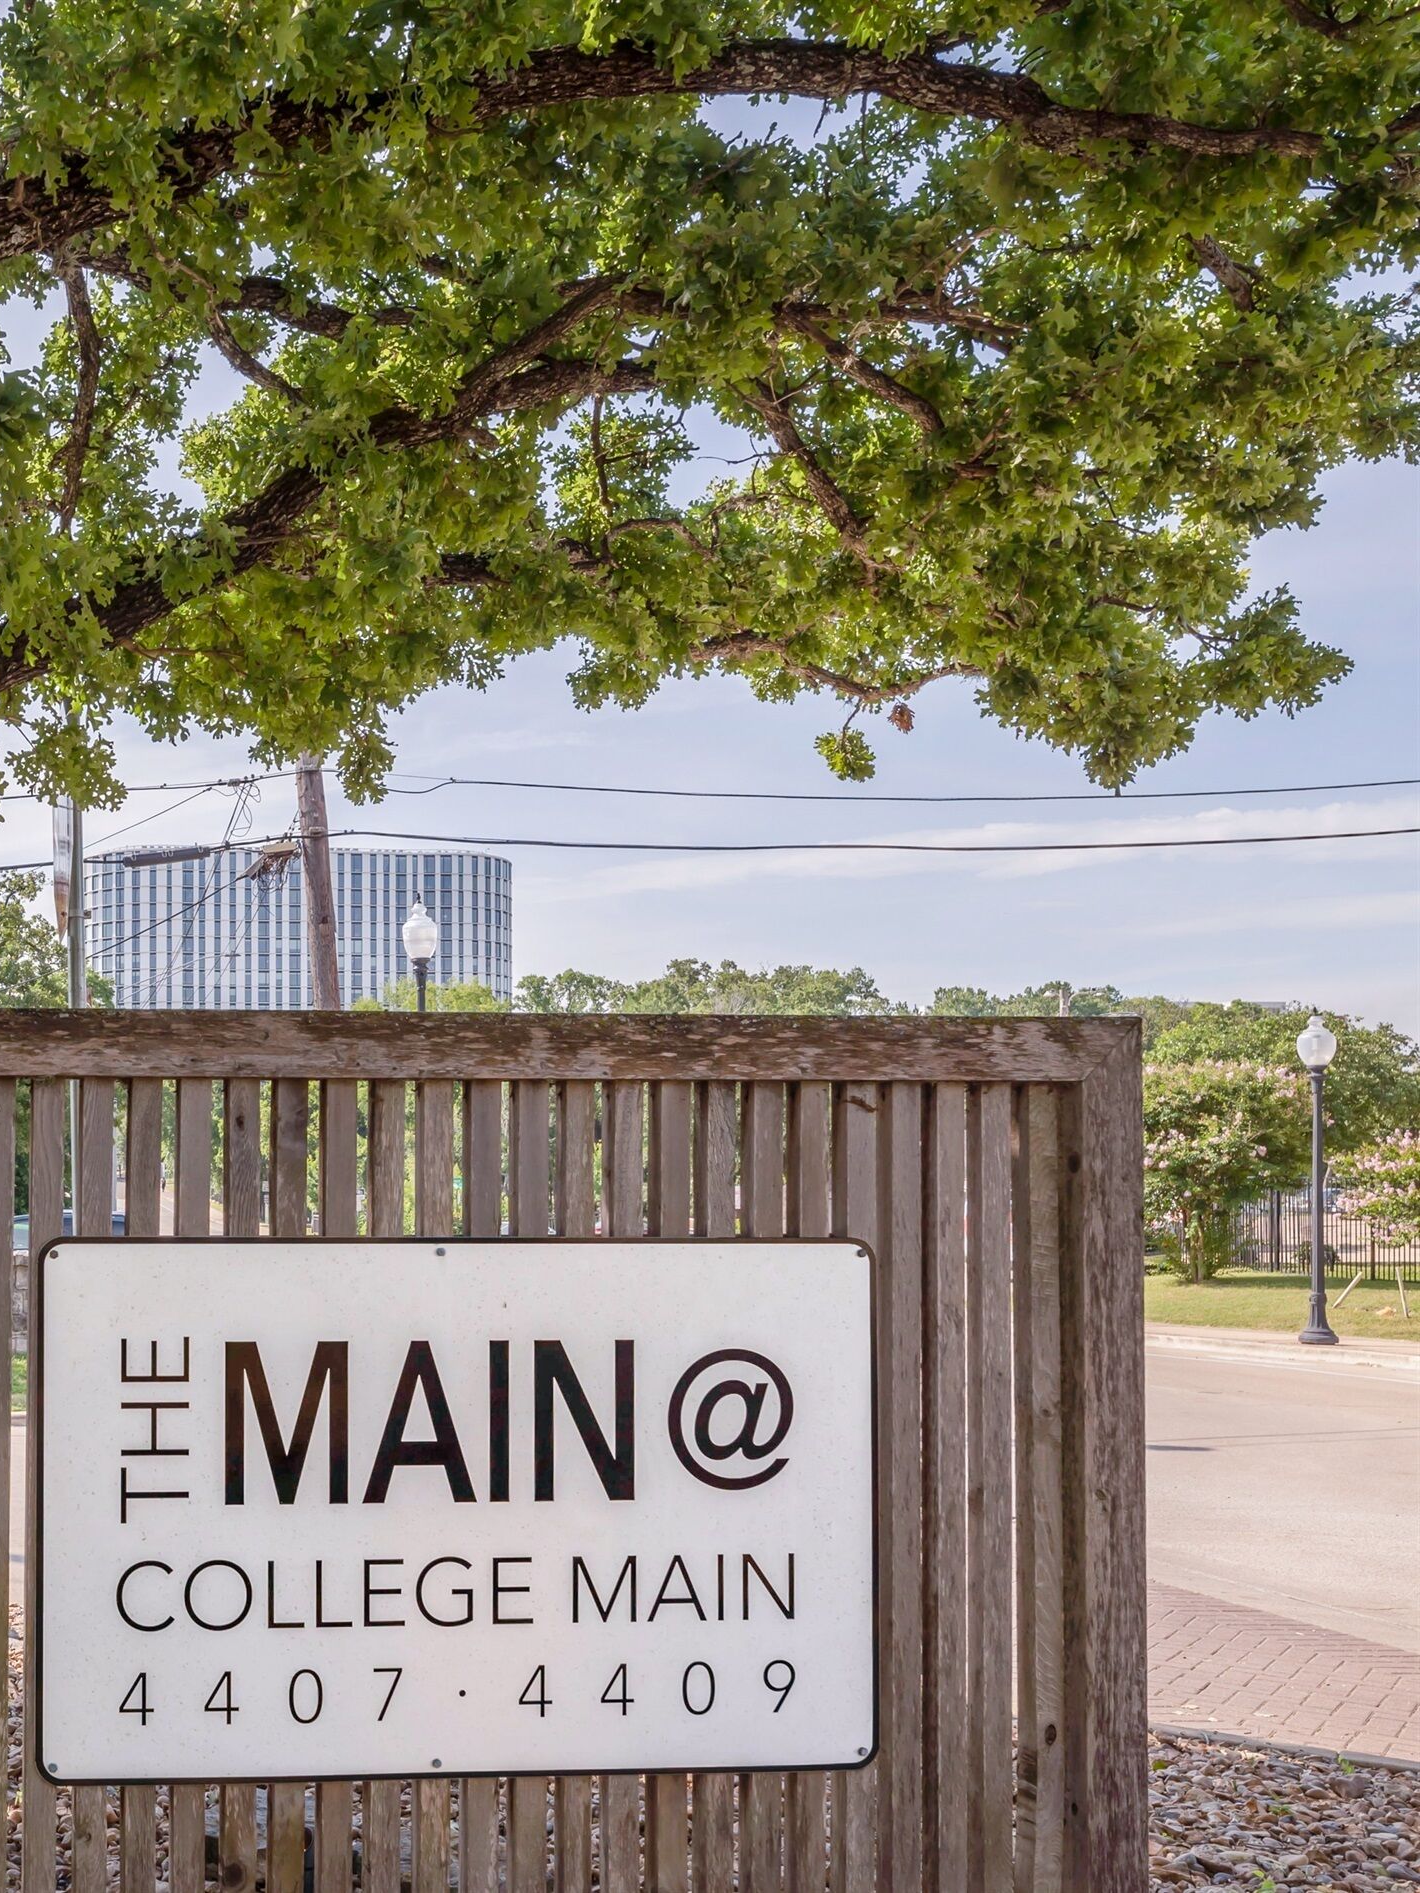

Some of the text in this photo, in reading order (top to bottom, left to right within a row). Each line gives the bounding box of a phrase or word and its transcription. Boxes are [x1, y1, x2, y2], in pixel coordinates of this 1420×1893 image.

[121, 1336, 189, 1524] THE
[116, 1553, 795, 1632] COLLEGE MAIN
[119, 1668, 402, 1726] 4407
[519, 1660, 795, 1717] 4409
